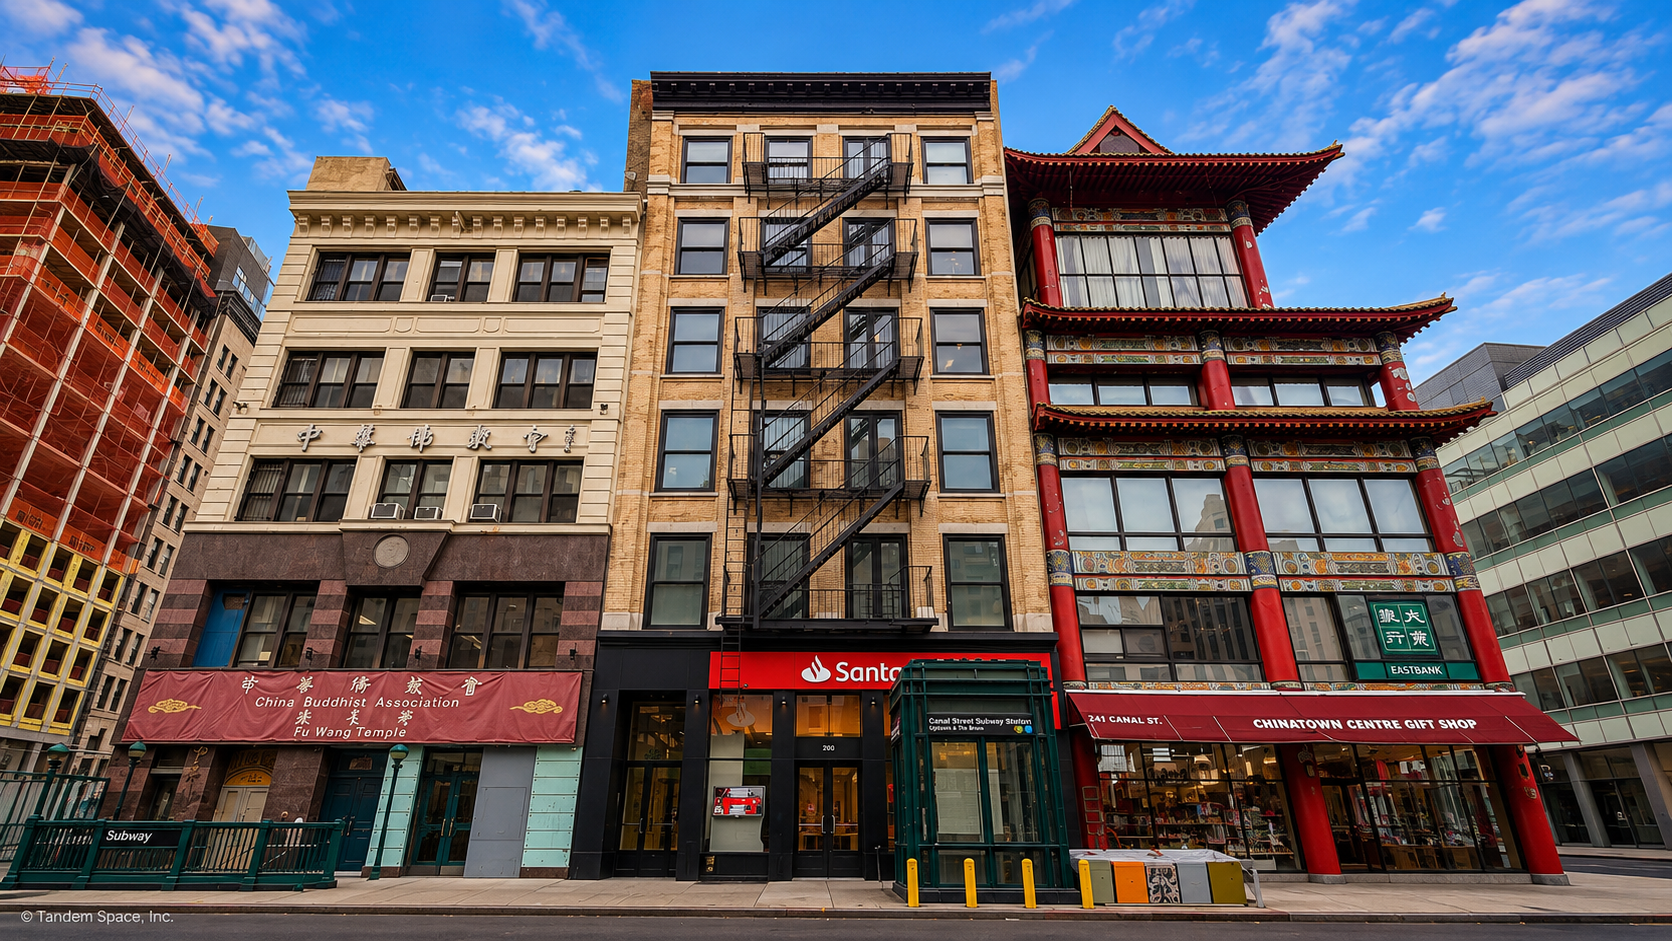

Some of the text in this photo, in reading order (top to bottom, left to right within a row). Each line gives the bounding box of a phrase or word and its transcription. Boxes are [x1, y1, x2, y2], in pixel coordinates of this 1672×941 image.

[1390, 665, 1443, 675] EASTBANK
[255, 696, 460, 708] China Buddhist Association
[1087, 714, 1163, 725] 241 CANAL ST.
[1252, 718, 1477, 730] CHINATOWN CENTRE GIFT SHOP
[293, 726, 407, 740] Fu Wang Temple
[822, 744, 835, 752] 200
[105, 829, 153, 844] Subway
